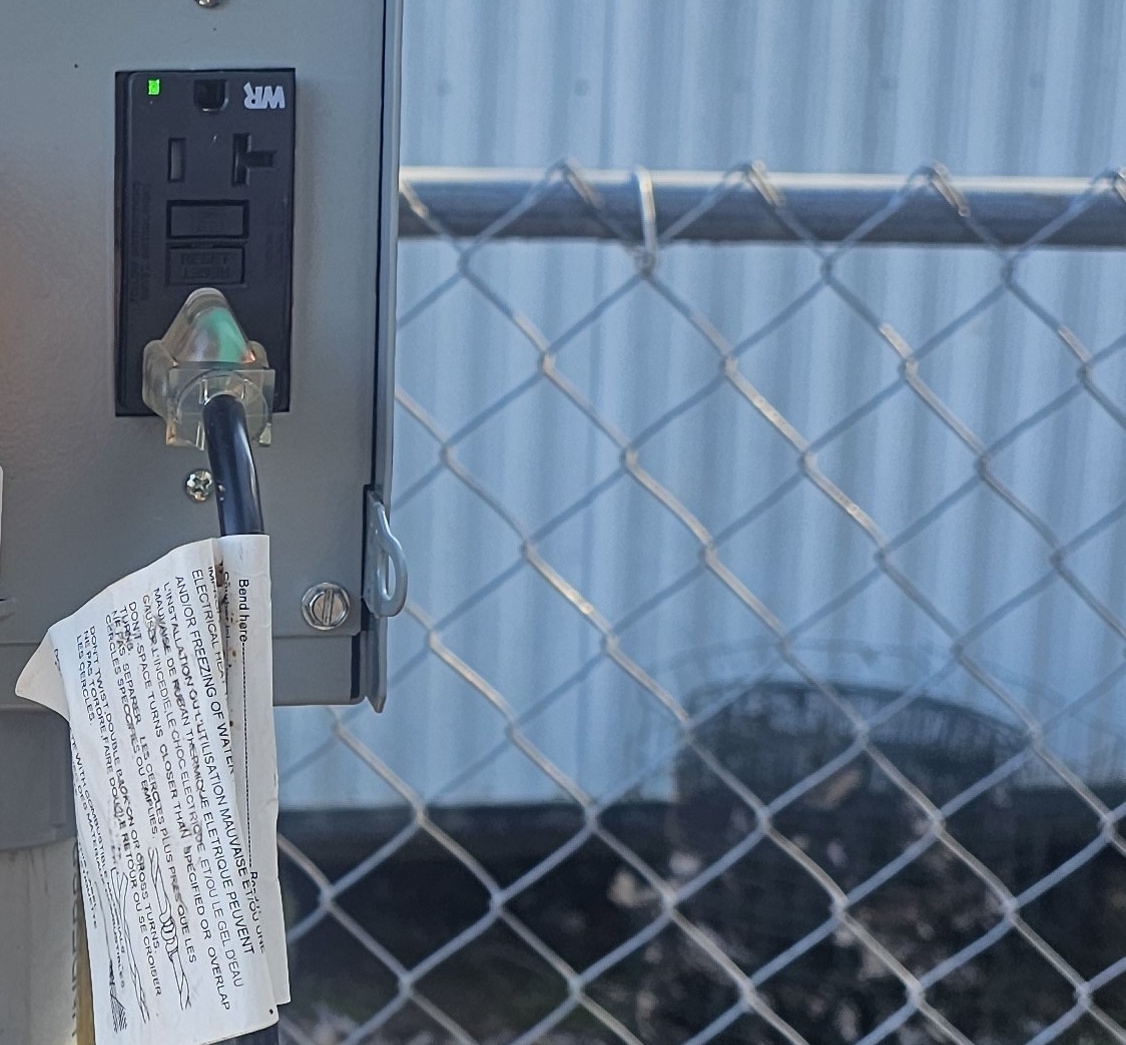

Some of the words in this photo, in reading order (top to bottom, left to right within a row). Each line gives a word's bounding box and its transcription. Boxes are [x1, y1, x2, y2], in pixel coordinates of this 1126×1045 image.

[244, 82, 285, 109] WR
[191, 569, 218, 648] ELECTRICAL
[238, 579, 249, 610] Bend
[174, 576, 196, 628] AND/OR
[192, 630, 216, 697] FREEZING
[210, 701, 224, 719] OF
[136, 644, 151, 689] SPACE
[147, 691, 163, 737] TURNS
[159, 743, 177, 799] CLOSER
[207, 946, 230, 1010] OVERLAP
[219, 808, 248, 876] MAUVAISE
[203, 811, 233, 888] ELETRIQUE
[225, 891, 254, 954] PEUVENT
[211, 900, 223, 918] LE
[217, 920, 230, 947] GEL
[224, 949, 243, 987] D'EAU
